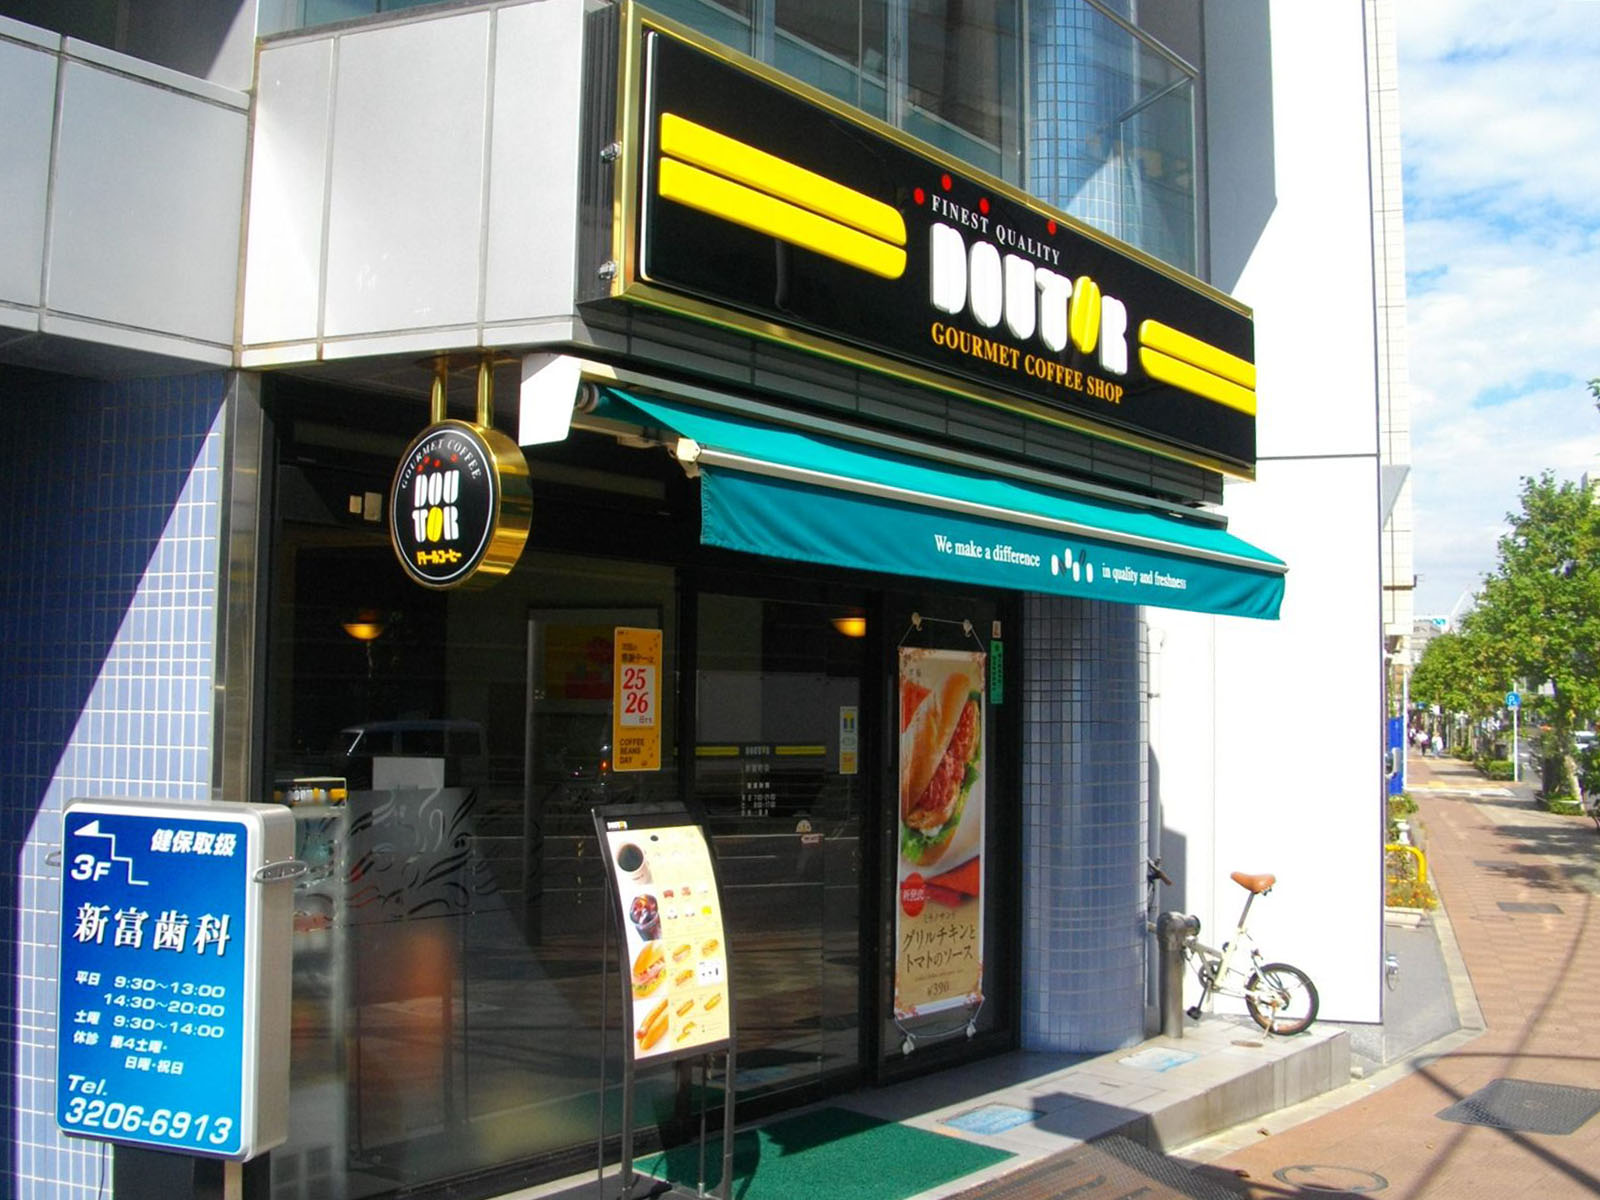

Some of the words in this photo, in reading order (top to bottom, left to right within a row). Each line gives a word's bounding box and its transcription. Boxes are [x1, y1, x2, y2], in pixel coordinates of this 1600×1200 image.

[931, 194, 989, 234] FINEST
[996, 222, 1061, 266] QUALITY
[930, 222, 1128, 376] DOUTOR
[931, 321, 1020, 371] GOURMET
[1024, 353, 1083, 396] COFFEE
[1087, 376, 1125, 405] SHOP
[447, 439, 482, 480] COFFEE
[934, 534, 953, 553] We
[955, 541, 983, 560] make
[985, 548, 991, 560] a
[993, 544, 1041, 568] difference
[1102, 562, 1111, 579] in
[1112, 566, 1138, 585] quality
[1139, 570, 1153, 585] and
[1154, 571, 1187, 590] freshness
[623, 668, 646, 690] 25
[625, 692, 649, 714] 26
[619, 738, 645, 747] COFFEE
[619, 747, 641, 756] BEANS
[619, 756, 633, 765] DAY
[150, 828, 237, 857] 健保取扱
[71, 853, 112, 883] 3F
[73, 902, 231, 957] 新富歯科
[903, 923, 976, 953] グリルチキンと
[907, 945, 974, 974] トマトのソース
[75, 970, 101, 986] 平日
[74, 1010, 101, 1025] 土曜
[73, 1031, 99, 1046] 休診
[67, 1074, 108, 1097] Tel.
[65, 1097, 233, 1146] 3206-6913
